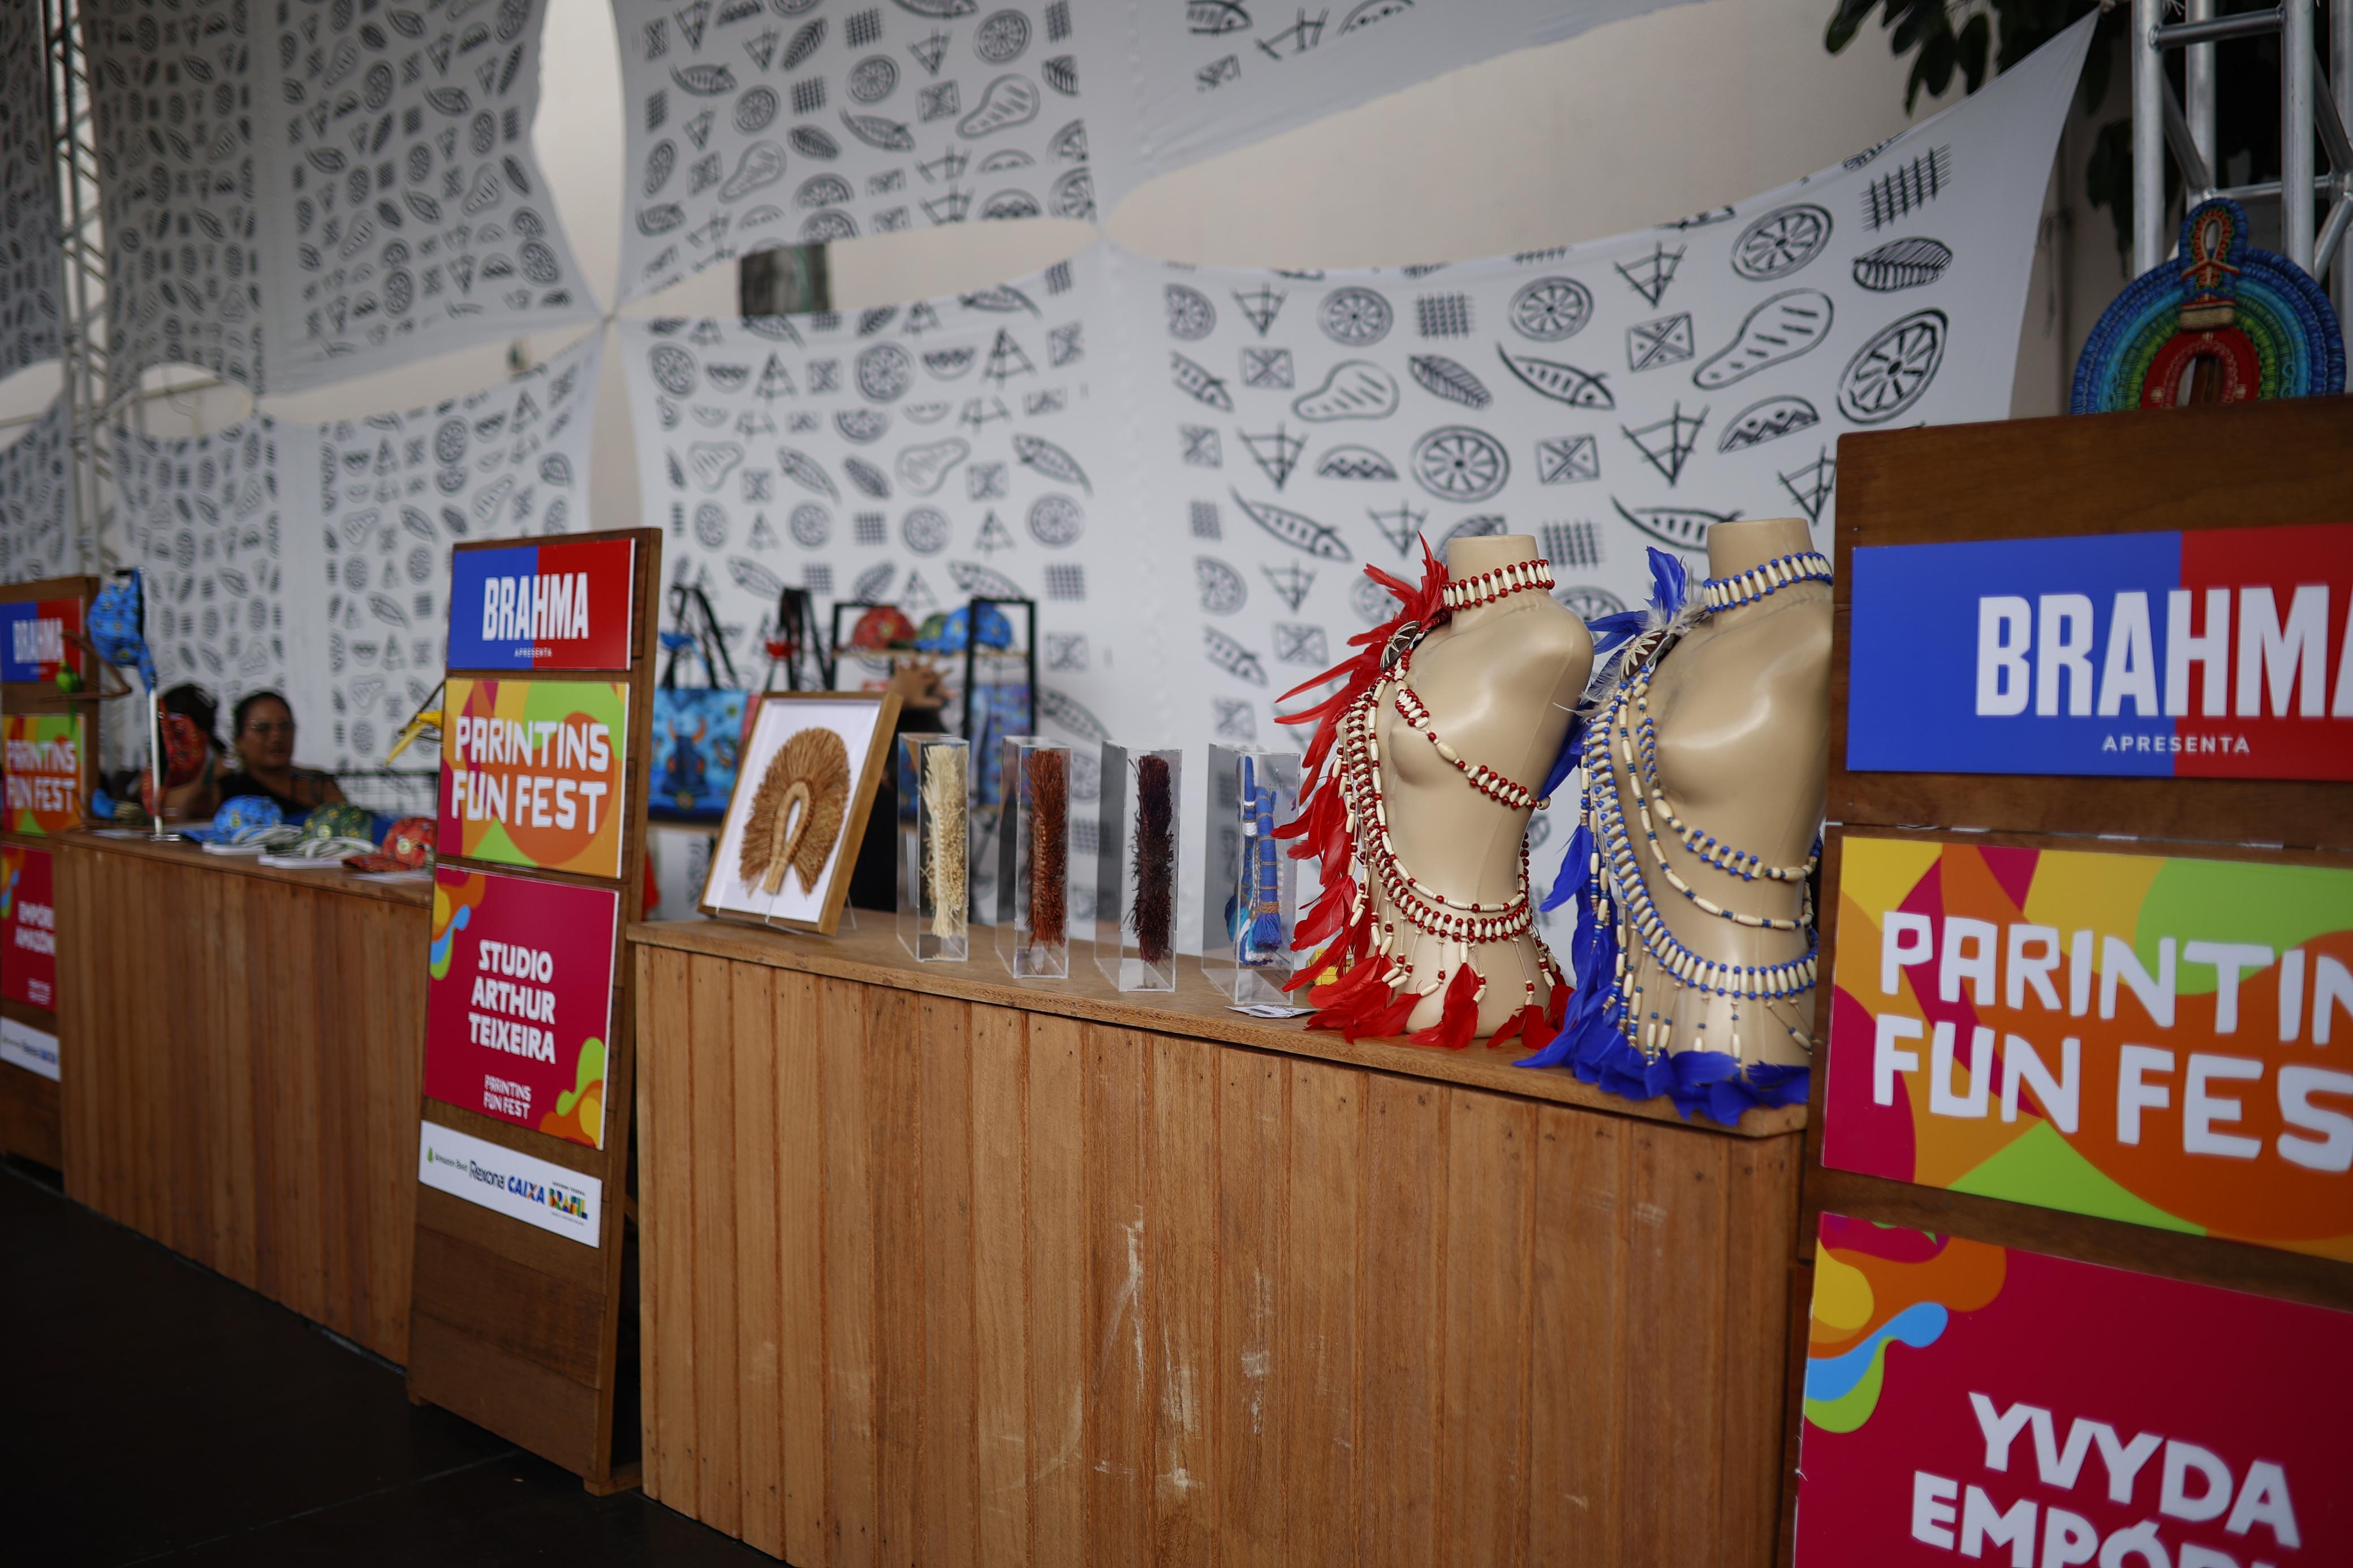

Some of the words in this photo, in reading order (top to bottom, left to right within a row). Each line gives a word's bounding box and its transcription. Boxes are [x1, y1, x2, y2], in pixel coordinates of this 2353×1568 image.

[481, 572, 589, 641] BRAHMA
[514, 647, 552, 658] APRESENTA
[456, 716, 610, 772] PARINTINS
[2102, 735, 2251, 754] APRESENTA
[35, 777, 76, 814] FEST
[451, 770, 508, 824] FUN
[515, 776, 607, 834] FEST
[479, 939, 553, 984] STUDIO
[471, 977, 556, 1025] ARTHUR
[468, 1013, 556, 1065] TEIXEIRA
[483, 1089, 502, 1112] FUN
[503, 1094, 531, 1120] FEST
[484, 1074, 531, 1102] PARINTINS
[1873, 1013, 2080, 1133] FUN
[2117, 1044, 2353, 1173] FES
[468, 1159, 505, 1190] Rexona
[507, 1176, 545, 1205] CAIXA
[548, 1188, 588, 1220] BRASIL
[1968, 1391, 2301, 1549] YVYDA
[1911, 1470, 2276, 1568] EMPÓ
